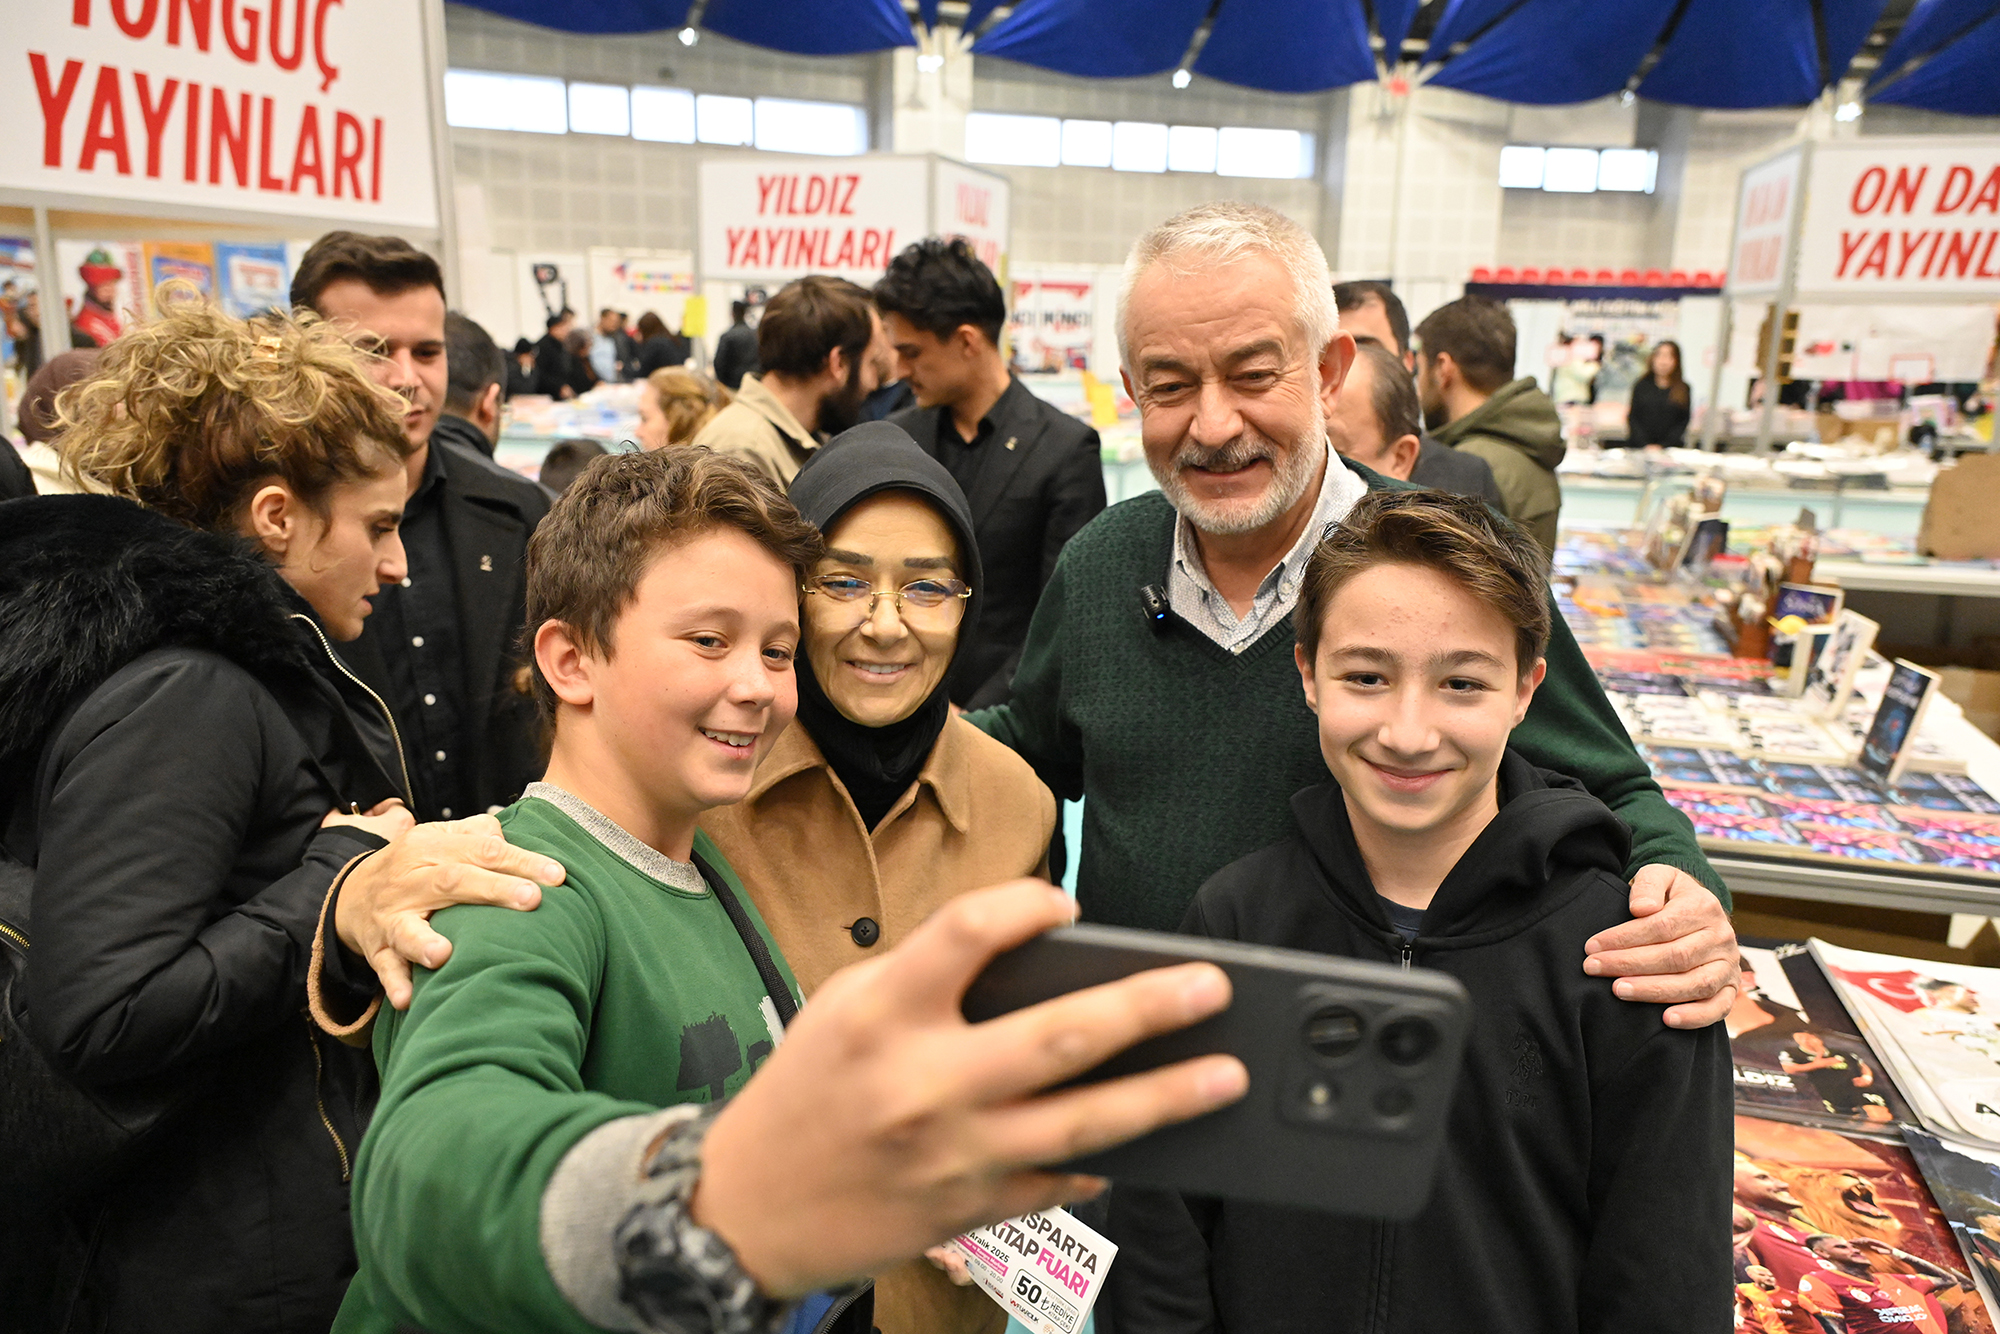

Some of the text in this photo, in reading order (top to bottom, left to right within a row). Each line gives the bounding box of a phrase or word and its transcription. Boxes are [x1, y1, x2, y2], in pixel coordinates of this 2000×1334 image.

[72, 0, 345, 94] NGUÇ
[27, 49, 382, 204] YAYINLARI
[757, 173, 863, 216] YILDIZ
[1849, 164, 1929, 216] ON
[725, 227, 896, 269] YAYINLARI
[969, 1231, 1010, 1263] Aralık 2025
[1016, 1275, 1042, 1304] 50
[1036, 1247, 1090, 1298] FUARI
